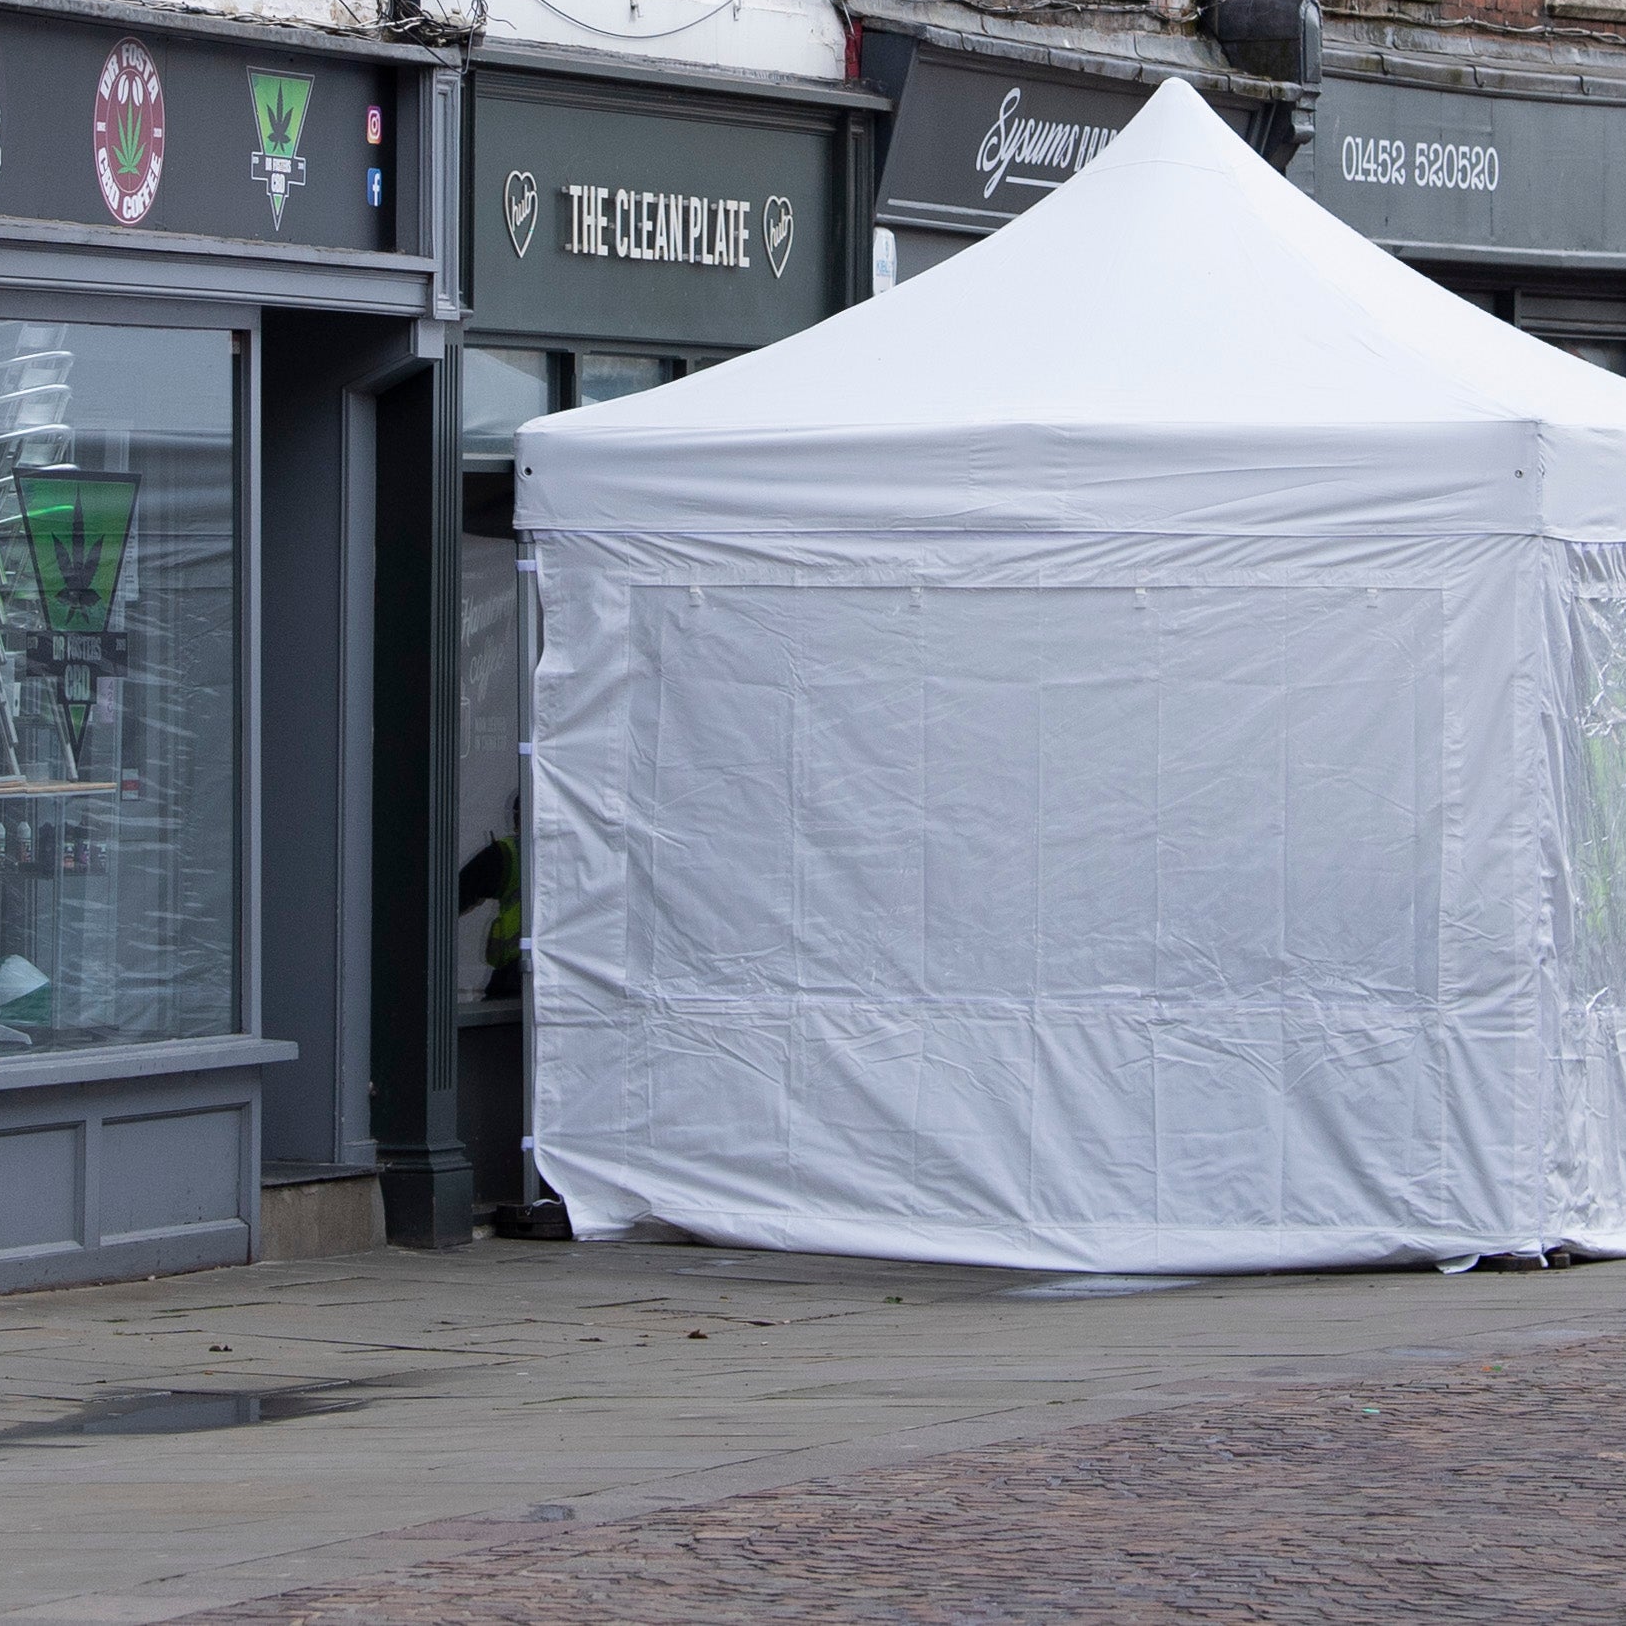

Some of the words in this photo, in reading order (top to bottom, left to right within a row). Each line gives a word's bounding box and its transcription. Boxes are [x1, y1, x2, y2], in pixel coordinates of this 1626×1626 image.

[100, 54, 119, 101] DR
[121, 43, 159, 105] FOSTA
[975, 87, 1080, 199] Sysums
[1342, 135, 1406, 184] 01452
[1414, 142, 1499, 191] 520520
[98, 147, 121, 211] CBD
[122, 152, 162, 219] COFFEE
[569, 185, 609, 256] THE
[614, 188, 684, 262] CLEAN
[689, 196, 751, 268] PLATE
[64, 664, 91, 702] CBD
